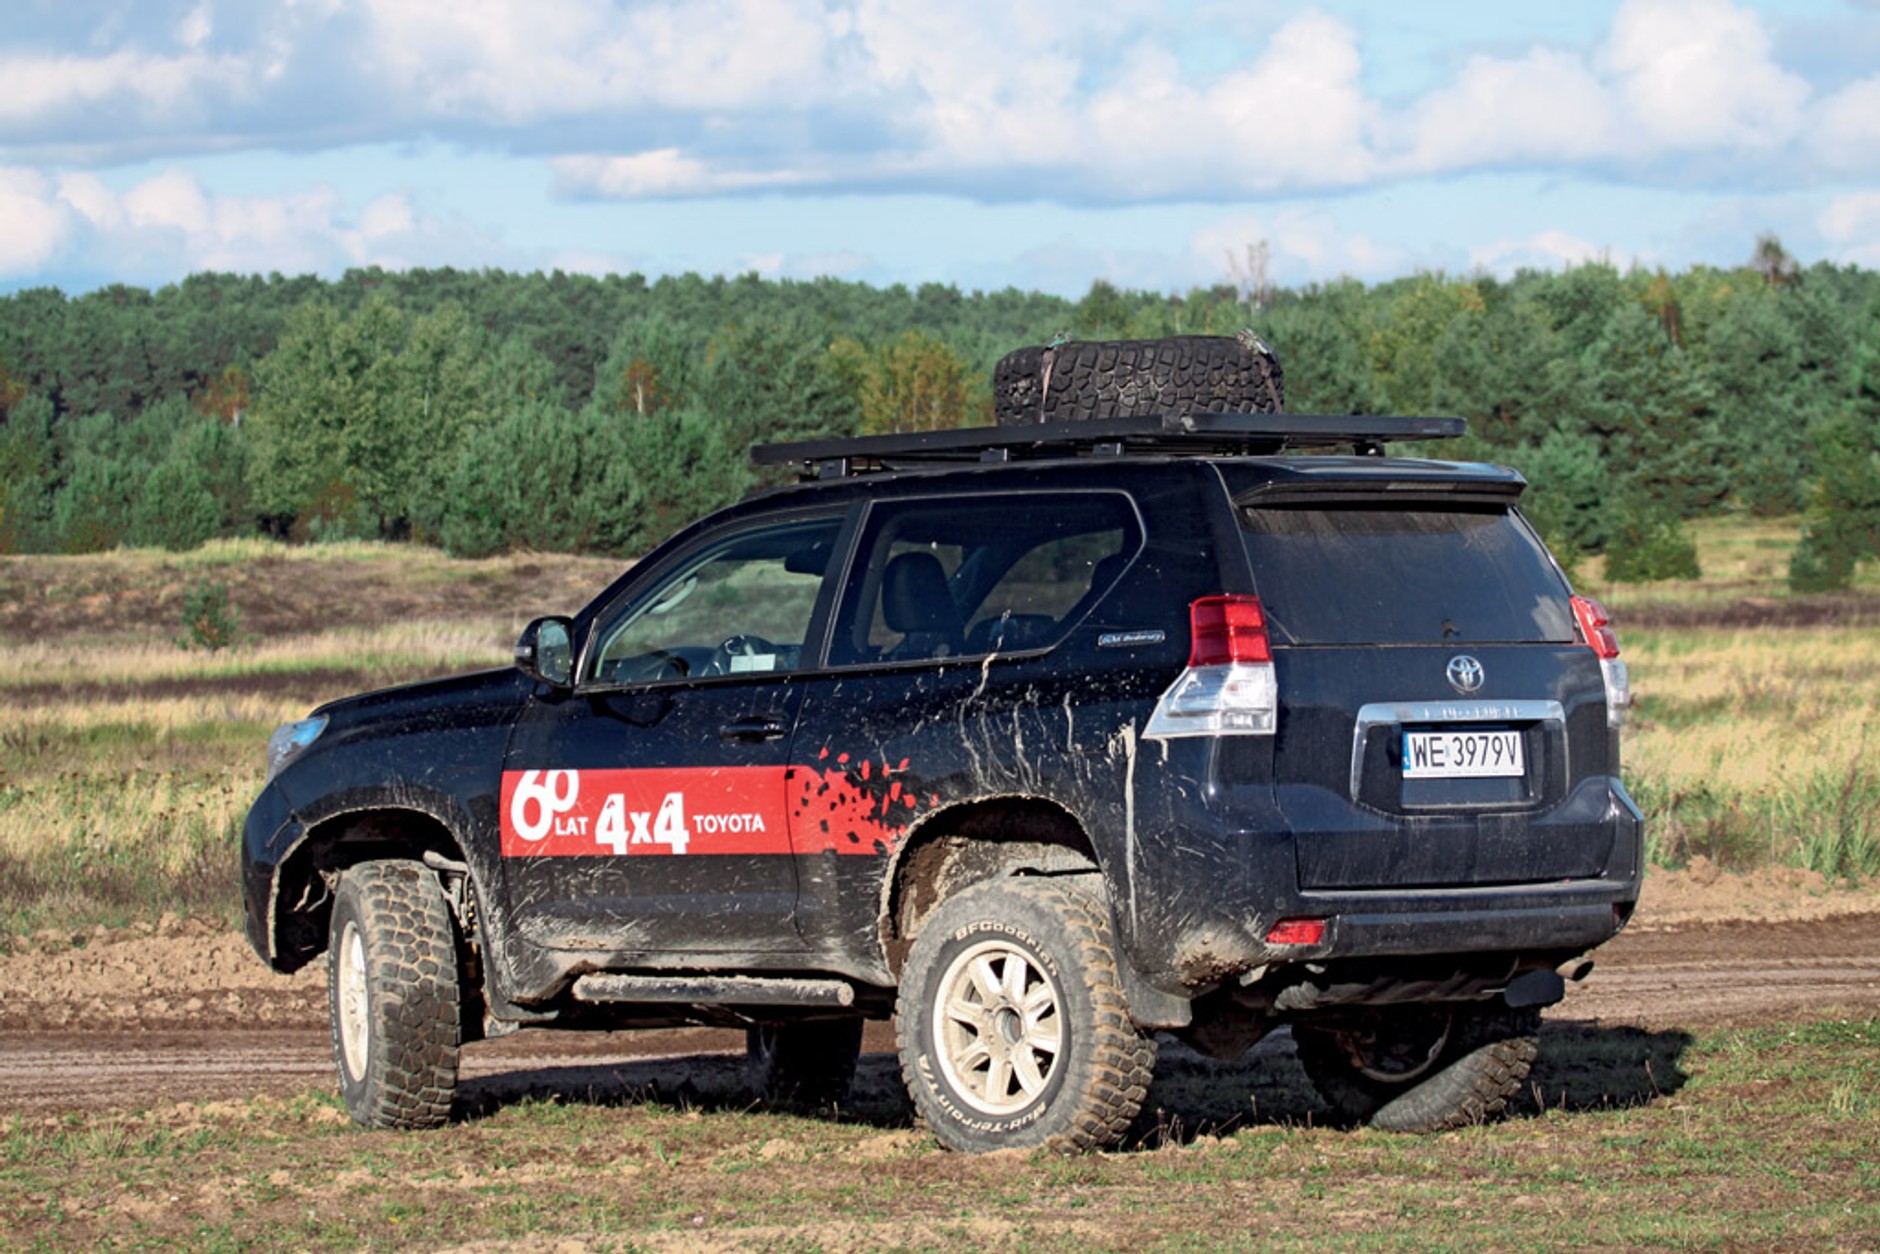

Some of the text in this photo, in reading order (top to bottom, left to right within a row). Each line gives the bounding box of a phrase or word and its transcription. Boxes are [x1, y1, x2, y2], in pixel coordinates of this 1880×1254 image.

[1412, 735, 1516, 768] WE 3979V
[510, 769, 766, 855] 60 LAT 4x4 TOYOTA
